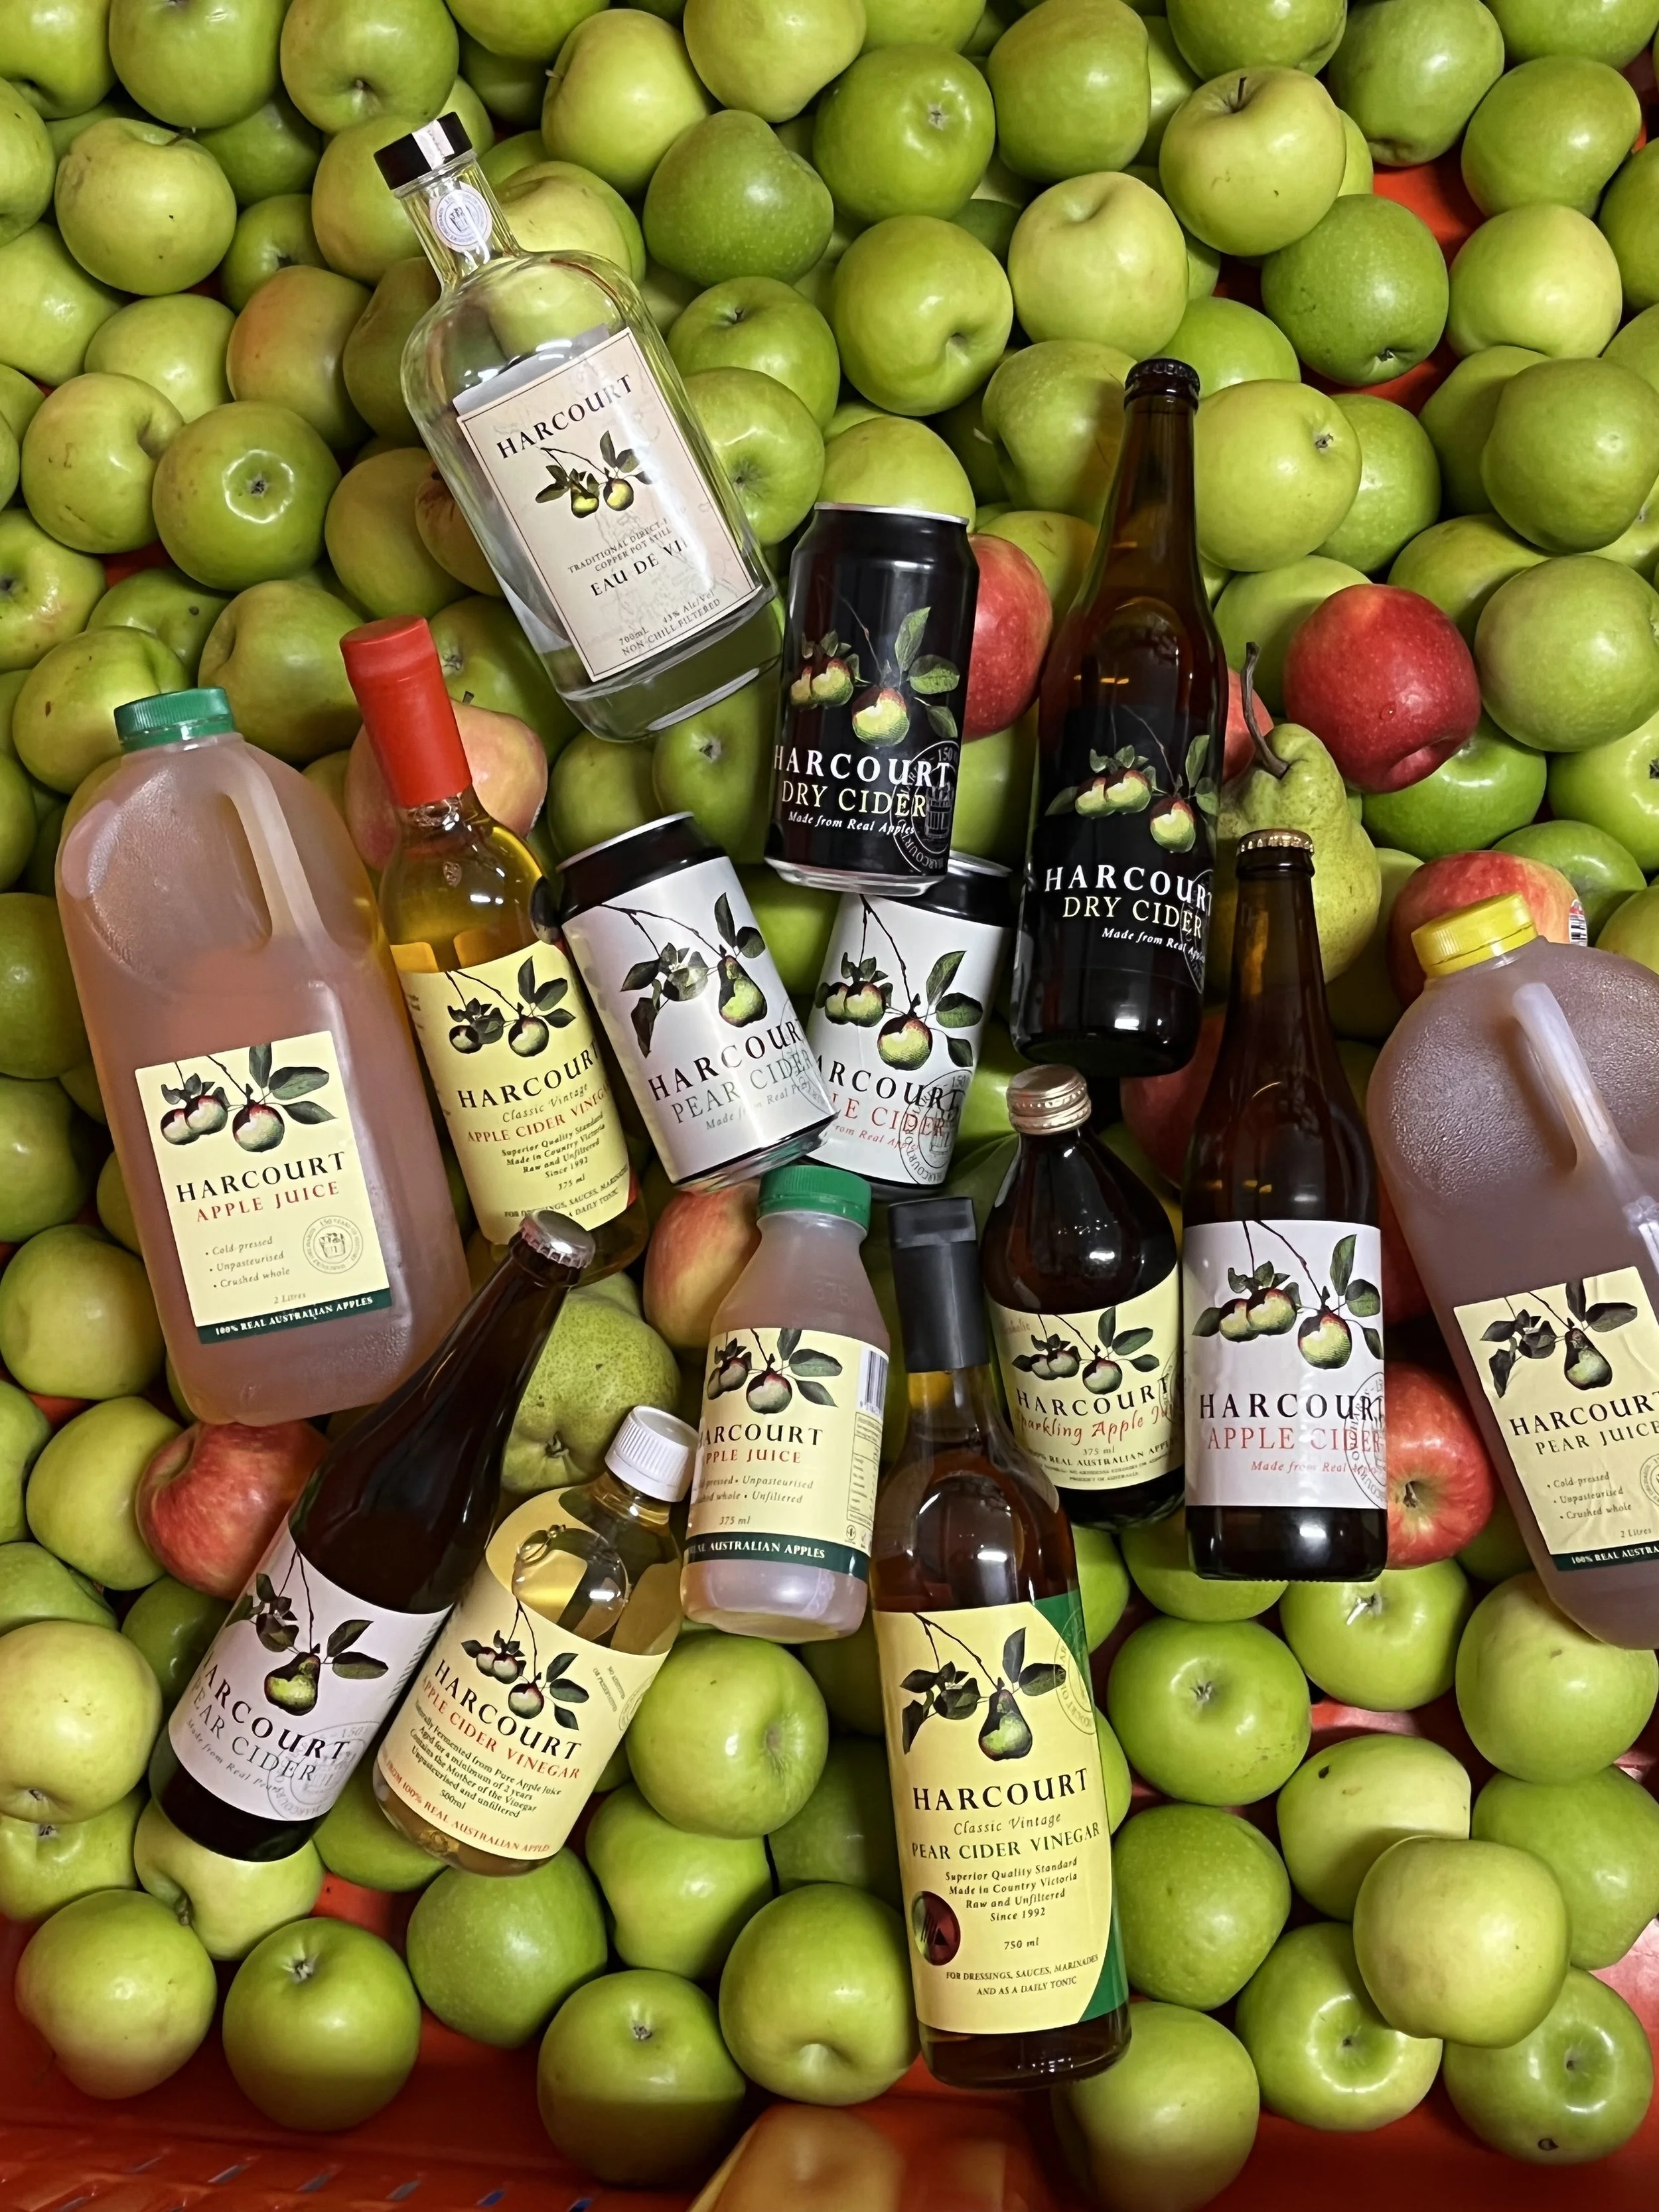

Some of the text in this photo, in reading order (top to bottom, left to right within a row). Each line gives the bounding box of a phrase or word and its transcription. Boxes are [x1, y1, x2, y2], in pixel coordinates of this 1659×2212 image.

[496, 374, 632, 459] HARCOURT
[568, 540, 628, 573] TRADITIONAL
[595, 540, 648, 572] COPPER POT
[590, 553, 659, 596] EAU DE
[619, 627, 649, 646] 700mL
[622, 598, 721, 656] NON CHILL FILTERED
[774, 745, 950, 788] HARCOURT
[782, 780, 926, 818] DRY CIDER
[788, 810, 914, 836] Made from Real Apples
[1062, 896, 1201, 939] DRY CIDER
[1102, 927, 1186, 951] Made from Real
[648, 1020, 804, 1101] HARCOUR
[672, 1049, 814, 1124] PEAR CIDER
[502, 1083, 588, 1123] Classic Vintage
[705, 1112, 734, 1130] Made
[766, 1087, 789, 1105] Real
[468, 1114, 565, 1143] APPLE CIDER
[502, 1111, 603, 1157] Superior Quality Standard
[859, 1130, 885, 1143] Real
[871, 1106, 945, 1137] CIDER
[506, 1157, 530, 1166] Made
[544, 1141, 578, 1157] Country
[580, 1124, 605, 1143] Victoria
[523, 1138, 600, 1173] Raw and Unfiltered
[176, 1151, 345, 1203] HARCOURT
[545, 1156, 588, 1178] Since 1992
[558, 1173, 585, 1191] 375 ml
[197, 1181, 340, 1222] APPLE JUICE
[575, 1199, 597, 1216] DAILY
[216, 1250, 284, 1272] Unpasteurised
[220, 1268, 291, 1288] Crushed whole
[273, 1292, 307, 1305] 2 Litres
[215, 1296, 373, 1335] 100% REAL AUSTRALIAN APPLES
[1017, 1373, 1169, 1416] HARCOURT
[1092, 1410, 1143, 1444] Apple
[1207, 1427, 1381, 1453] APPLE CIDER
[1536, 1420, 1659, 1455] PEAR JUICE
[747, 1449, 801, 1463] JUICE
[1049, 1455, 1072, 1466] REAL
[1076, 1451, 1144, 1467] AUSTRALIAN
[1082, 1445, 1116, 1456] 375 ml
[742, 1475, 814, 1489] Unpasteurised
[1251, 1461, 1284, 1472] Made
[1322, 1461, 1346, 1473] Real
[717, 1491, 741, 1501] whole
[752, 1491, 804, 1504] Unfiltered
[1559, 1485, 1624, 1505] Unpasteurised
[719, 1515, 751, 1525] 375 ml
[1566, 1503, 1632, 1519] Crushed whole
[1628, 1528, 1652, 1537] Litres
[710, 1540, 826, 1559] AUSTRALIAN APPLES
[1571, 1551, 1621, 1564] 100% REAL
[435, 1659, 582, 1759] HARCOURT
[422, 1676, 580, 1779] APPLE CIDER VINEGAR
[202, 1743, 251, 1781] from Real
[232, 1736, 317, 1781] CIDER
[410, 1728, 433, 1757] Contains
[435, 1755, 446, 1768] the
[447, 1764, 476, 1787] Mother
[488, 1790, 502, 1801] the
[506, 1796, 537, 1812] Vinegar
[419, 1726, 435, 1744] Aged
[434, 1740, 445, 1753] for
[451, 1756, 491, 1785] minimum
[509, 1789, 532, 1801] years
[433, 1726, 541, 1791] Fermented from Pure Apple
[411, 1745, 460, 1790] Unpasteurised
[460, 1788, 477, 1800] and
[477, 1797, 521, 1818] unfiltered
[912, 1767, 1087, 1810] HARCOURT
[424, 1801, 520, 1850] REAL AUSTRALIAN
[954, 1812, 1061, 1835] Classic Vintage
[912, 1822, 1100, 1860] PEAR CIDER VINEGAR
[946, 1856, 1078, 1883] Superior Quality Standard
[949, 1872, 1077, 1895] Made in Country Victoria
[966, 1887, 1066, 1909] Raw and Unfiltered
[989, 1907, 1046, 1922] Since 1992
[1003, 1937, 1039, 1951] 750 ml
[946, 1954, 1099, 1980] FOR SAUCES, MARINADES
[976, 1976, 1077, 1996] AND AS A DAILY TONIC
